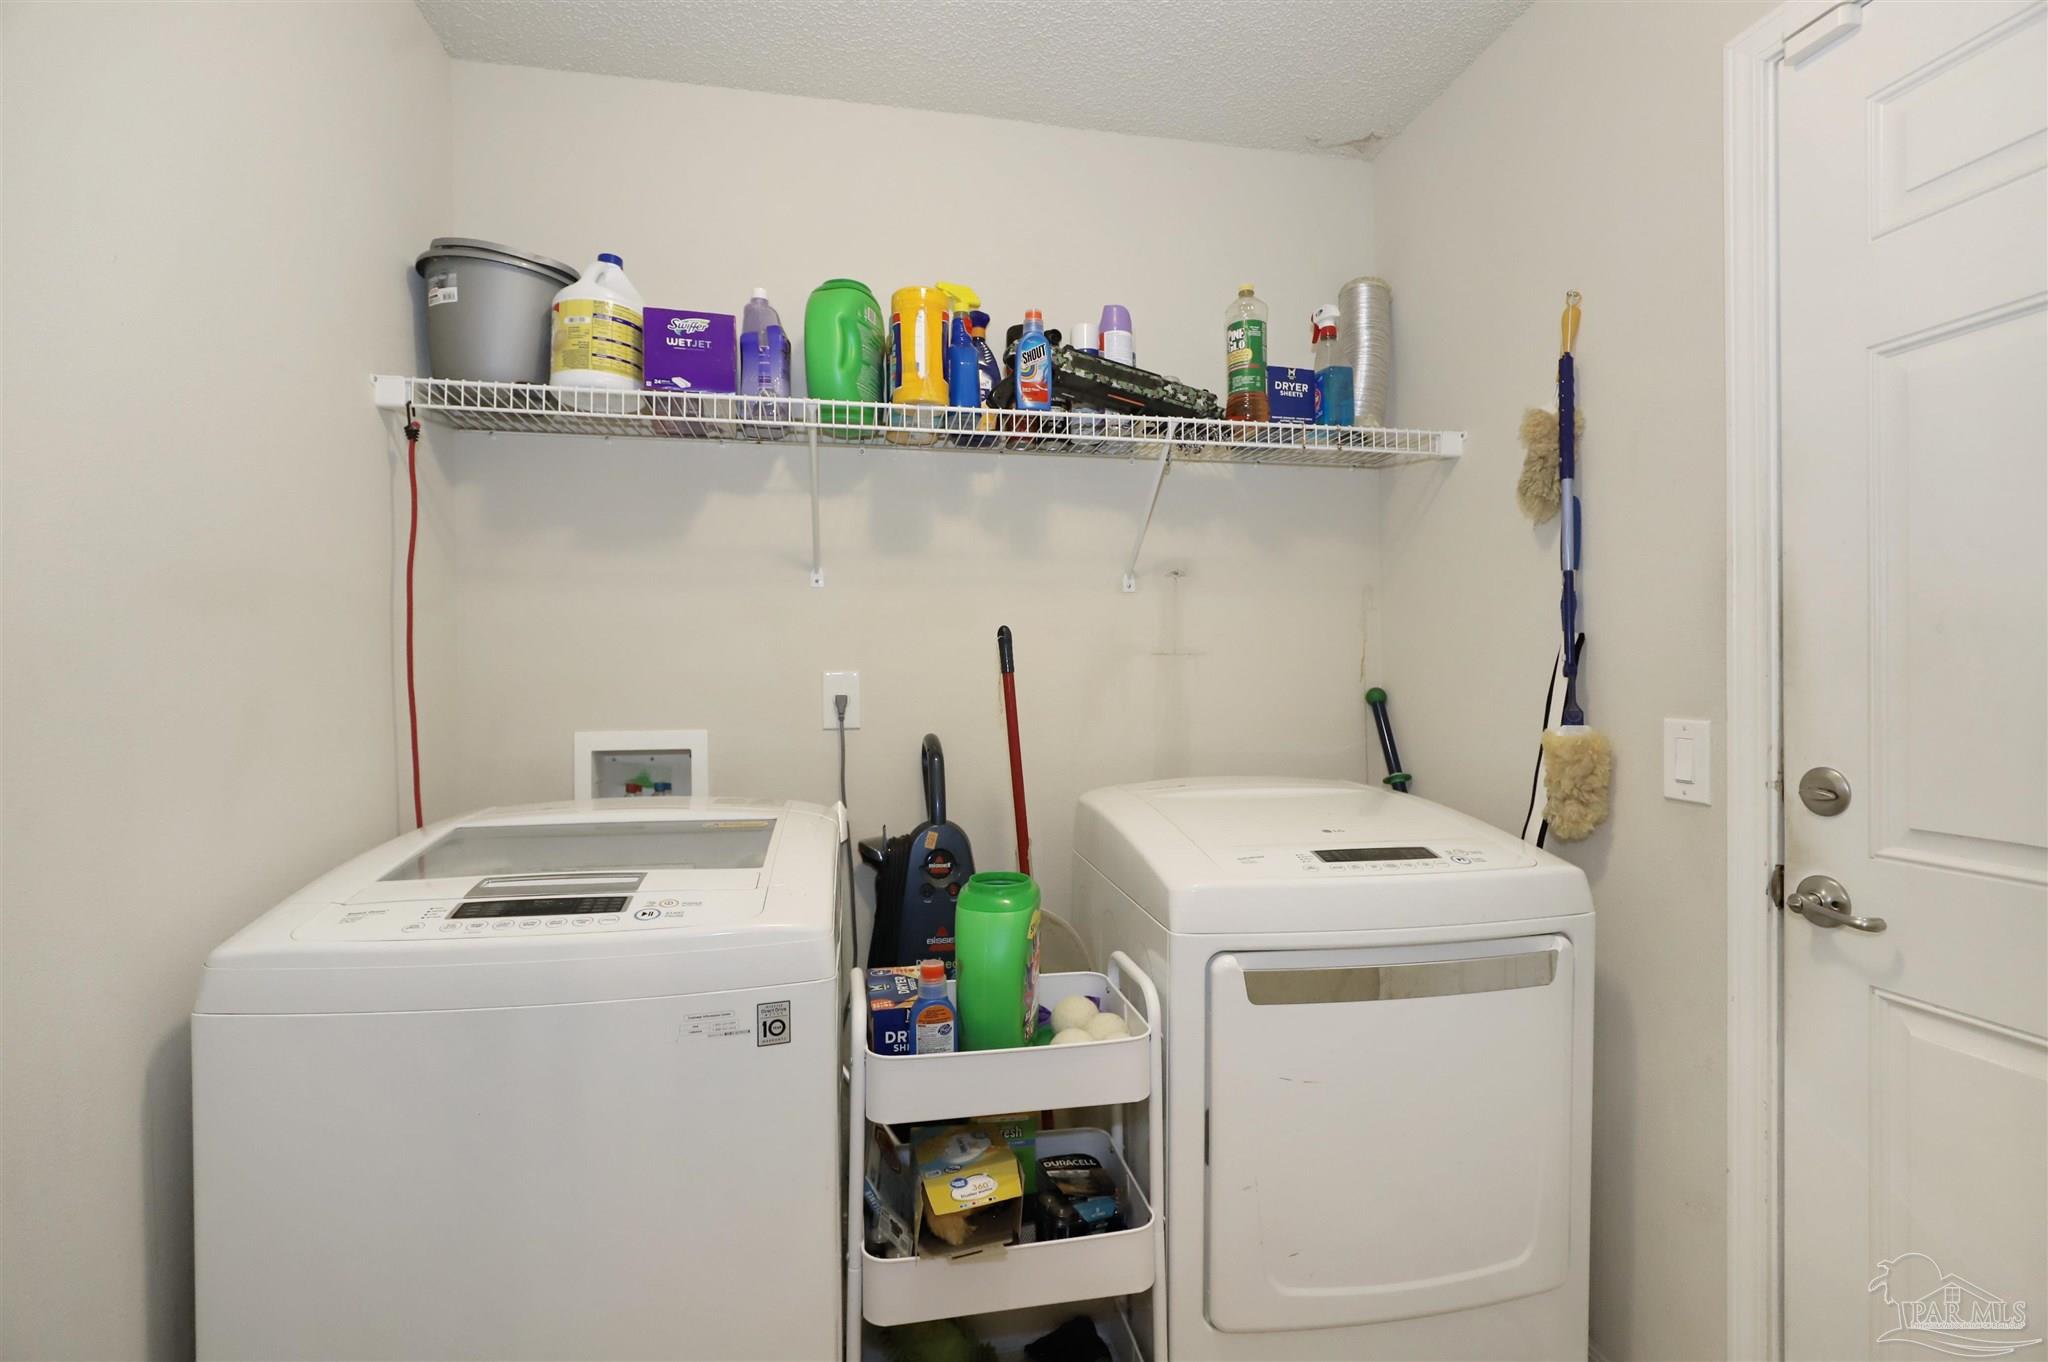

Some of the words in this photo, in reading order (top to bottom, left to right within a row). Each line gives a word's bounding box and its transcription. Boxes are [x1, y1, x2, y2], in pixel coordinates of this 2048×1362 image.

[667, 318, 709, 334] Swiffer
[1022, 344, 1046, 364] SHOUT
[1275, 381, 1309, 392] DRYER
[1280, 390, 1303, 398] SHEETS
[762, 1019, 786, 1038] 10
[1000, 1126, 1022, 1138] resh
[1043, 1159, 1097, 1168] DURACELL
